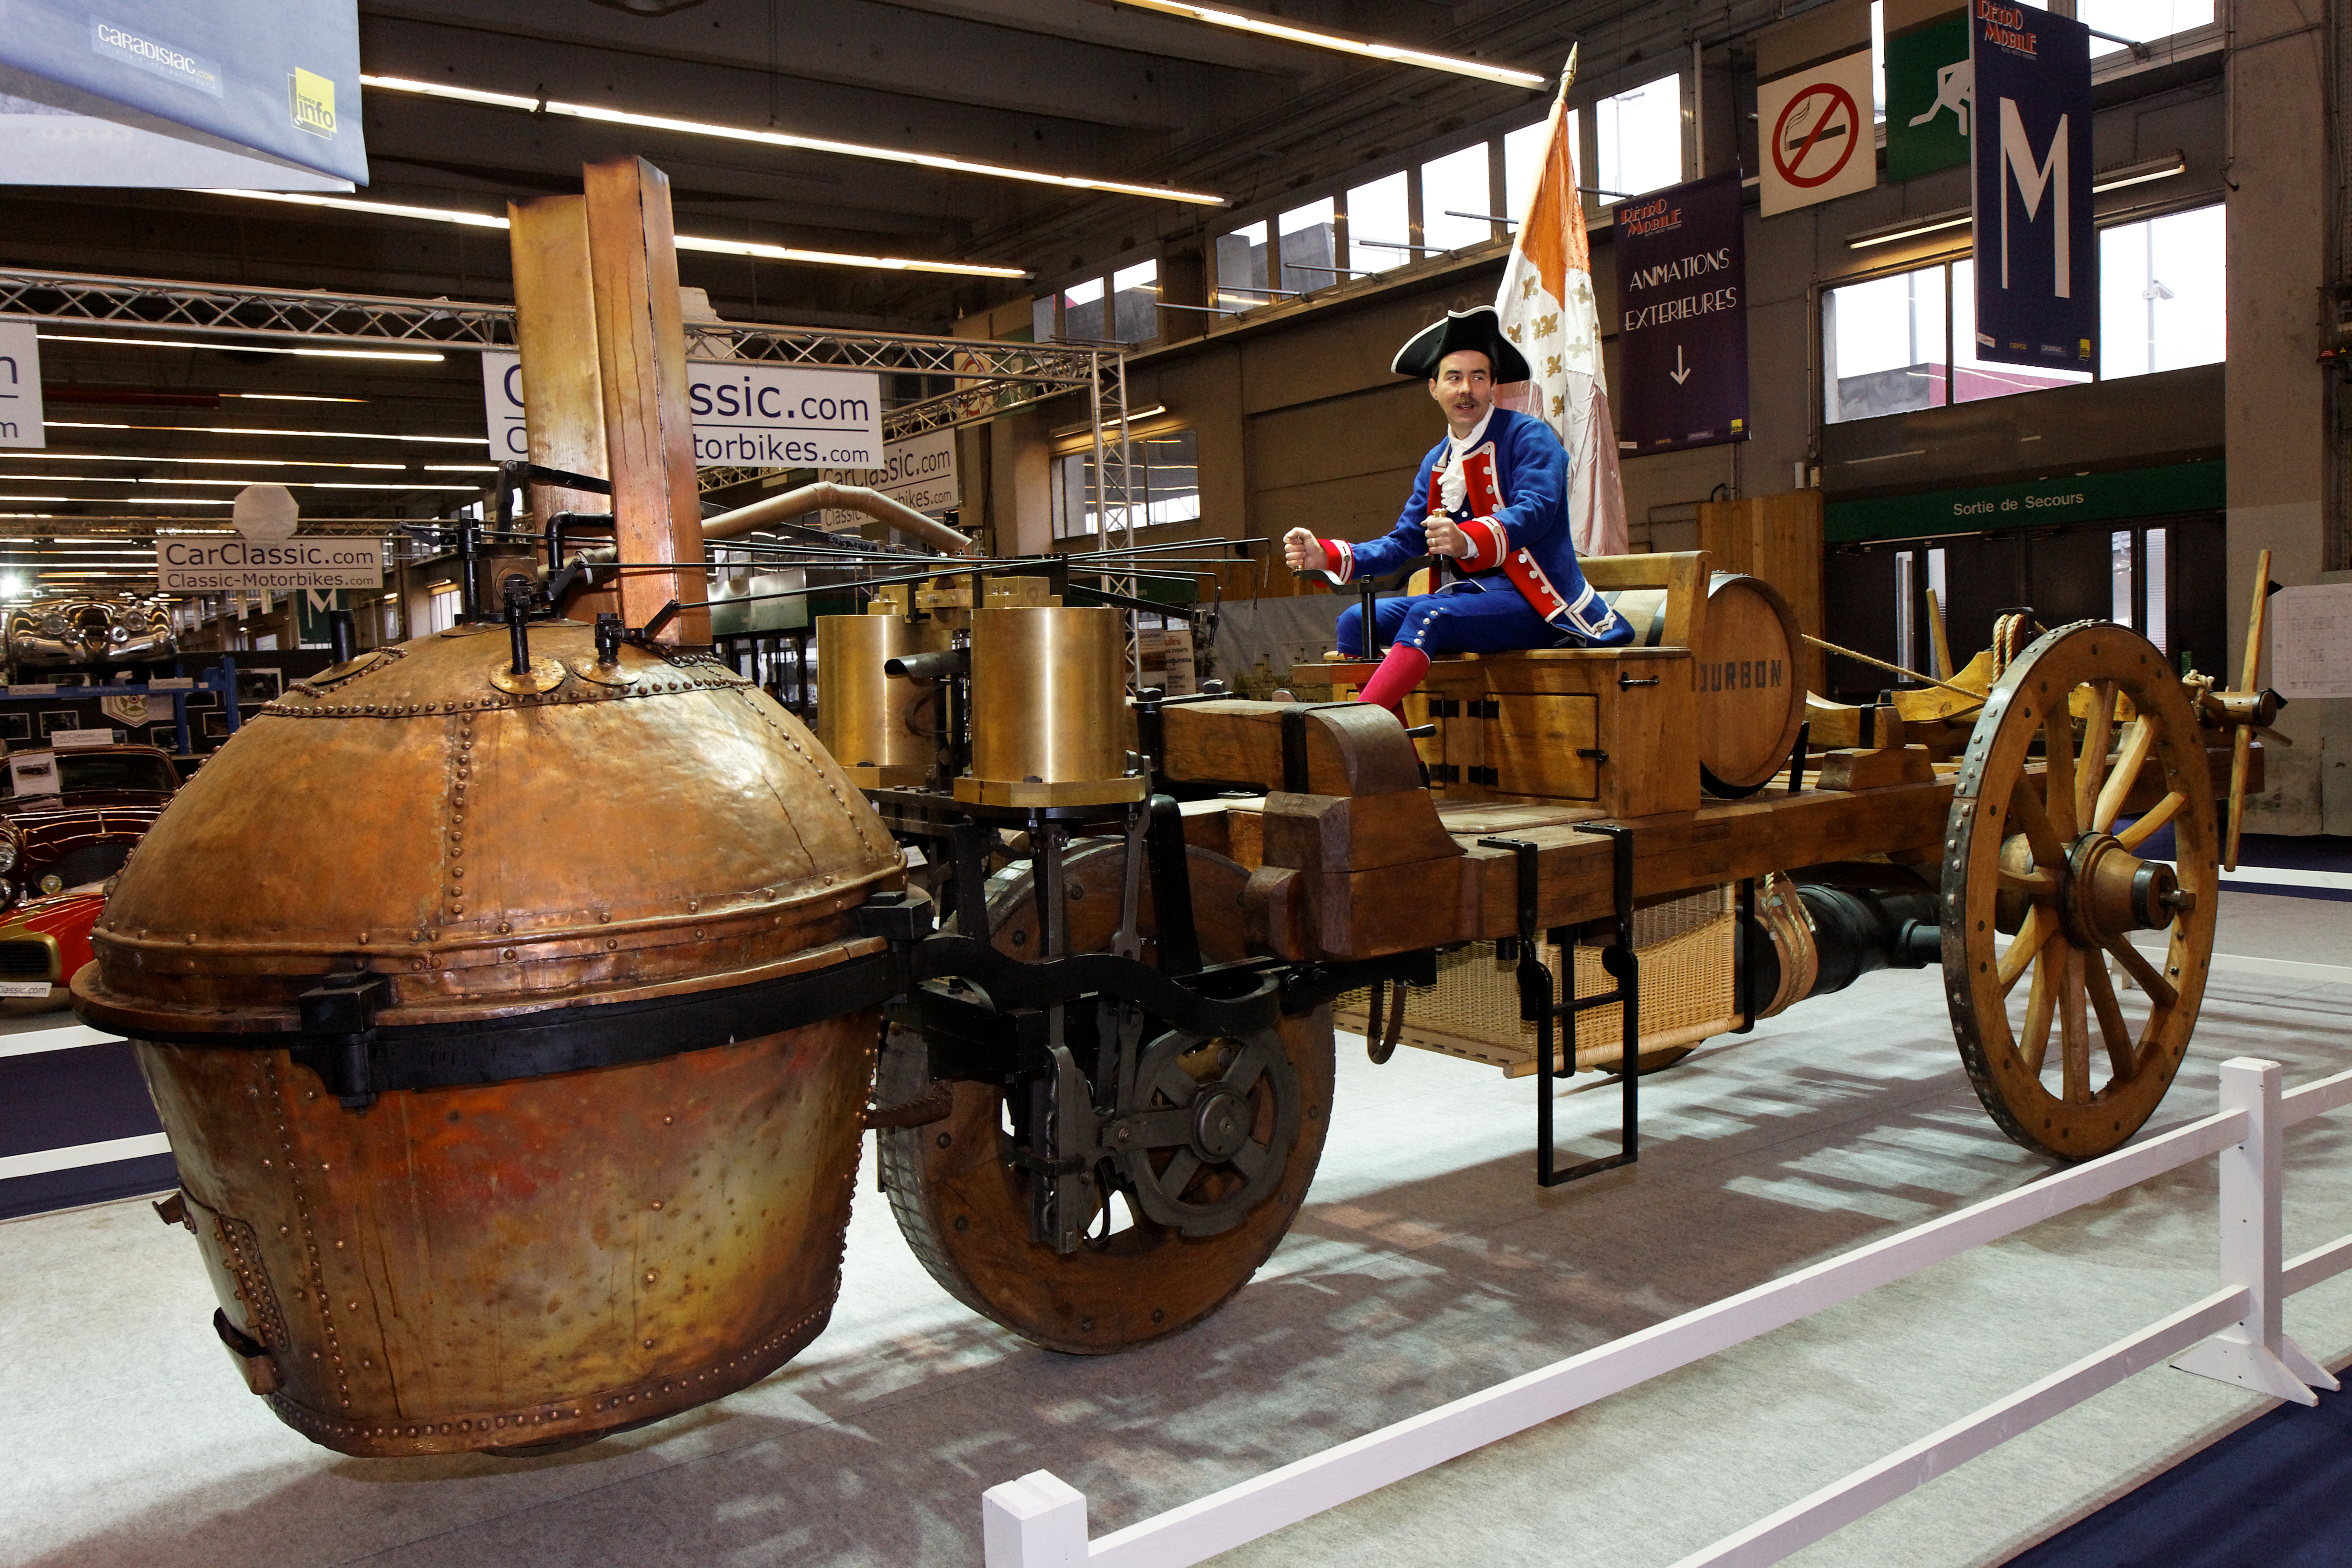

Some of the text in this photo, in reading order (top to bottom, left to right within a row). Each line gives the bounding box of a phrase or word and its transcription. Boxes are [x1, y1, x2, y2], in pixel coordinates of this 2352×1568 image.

[298, 93, 316, 104] france
[299, 101, 334, 128] info
[1999, 97, 2070, 299] M
[1629, 248, 1729, 292] ANIMATIONS
[1625, 287, 1737, 331] EXTERIEURES
[1954, 493, 2084, 515] Sortie de Secours
[166, 543, 373, 565] CarClassic.com
[167, 572, 373, 588] Classic-Motorbikes.com
[1700, 660, 1781, 693] OURBON
